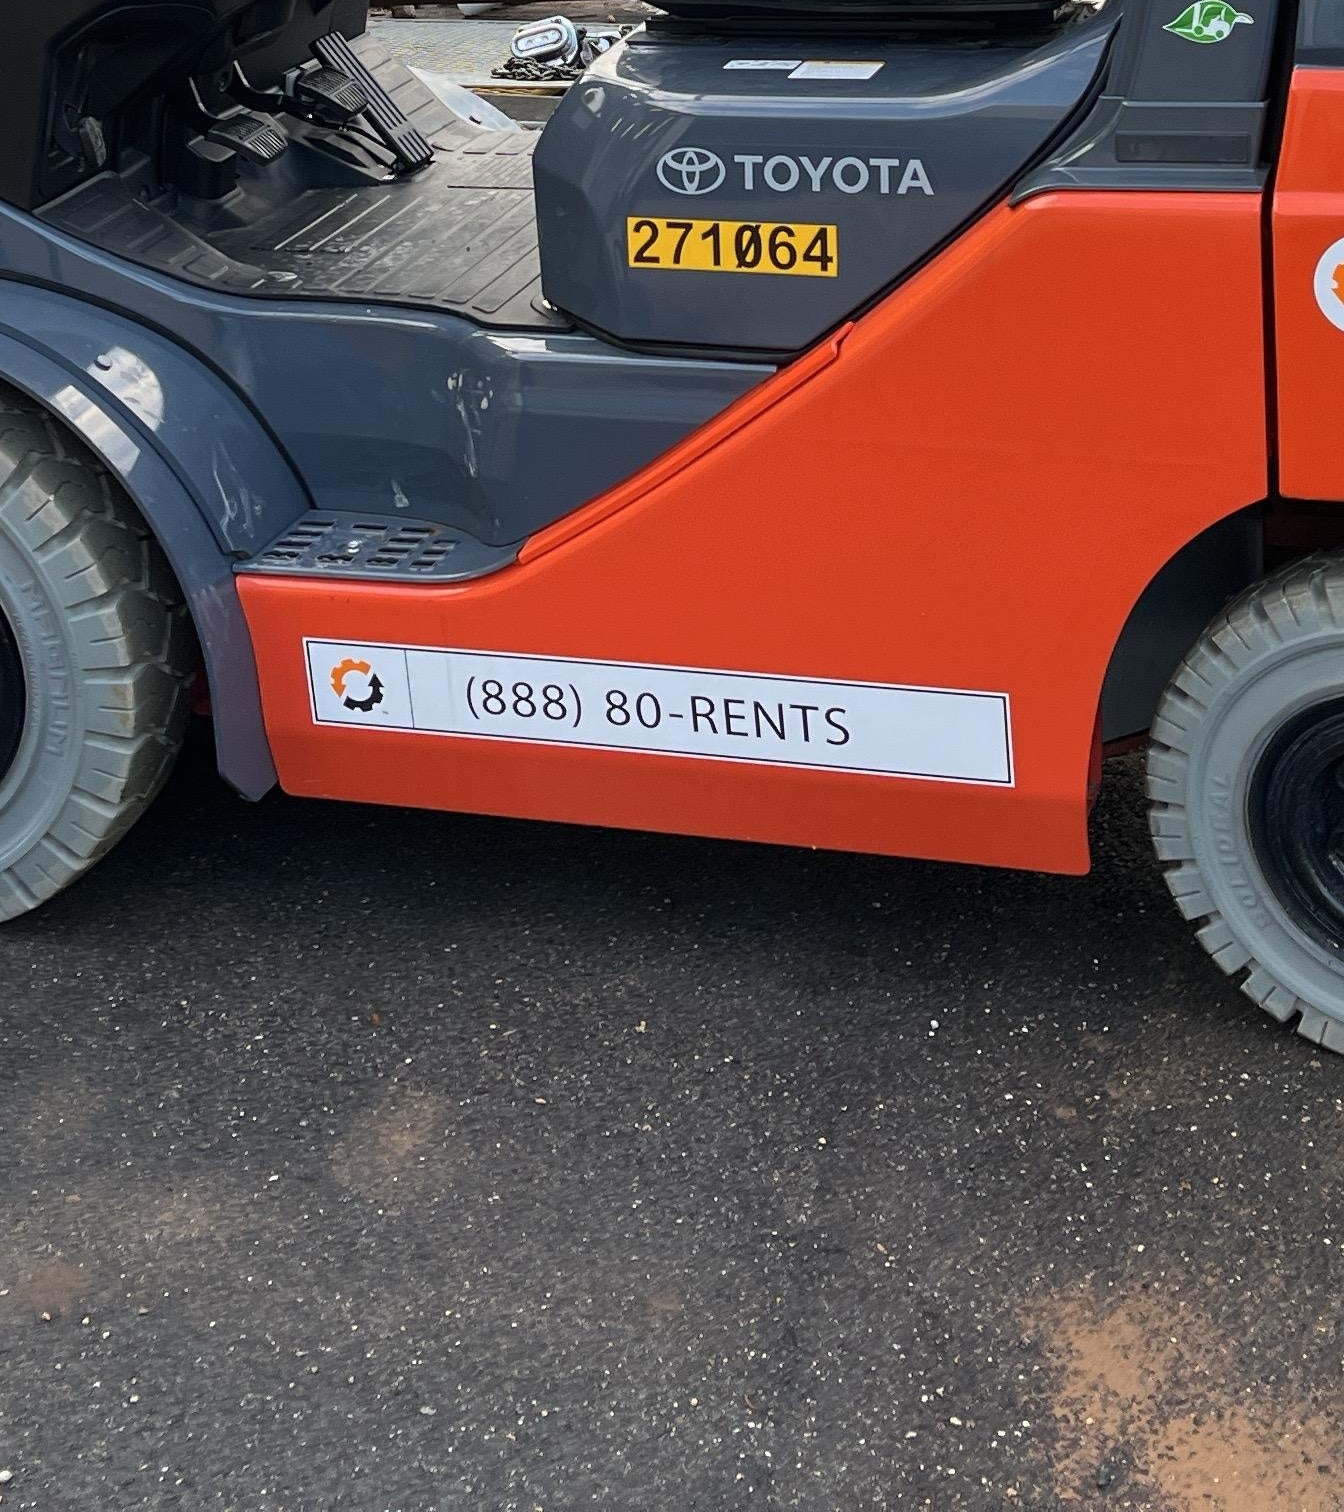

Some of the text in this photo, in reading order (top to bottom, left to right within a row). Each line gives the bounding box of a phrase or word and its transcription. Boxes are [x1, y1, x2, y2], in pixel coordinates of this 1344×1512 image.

[734, 154, 935, 196] TOYOTA
[632, 220, 834, 272] 271064
[466, 676, 851, 746] (888) 80-RENTS
